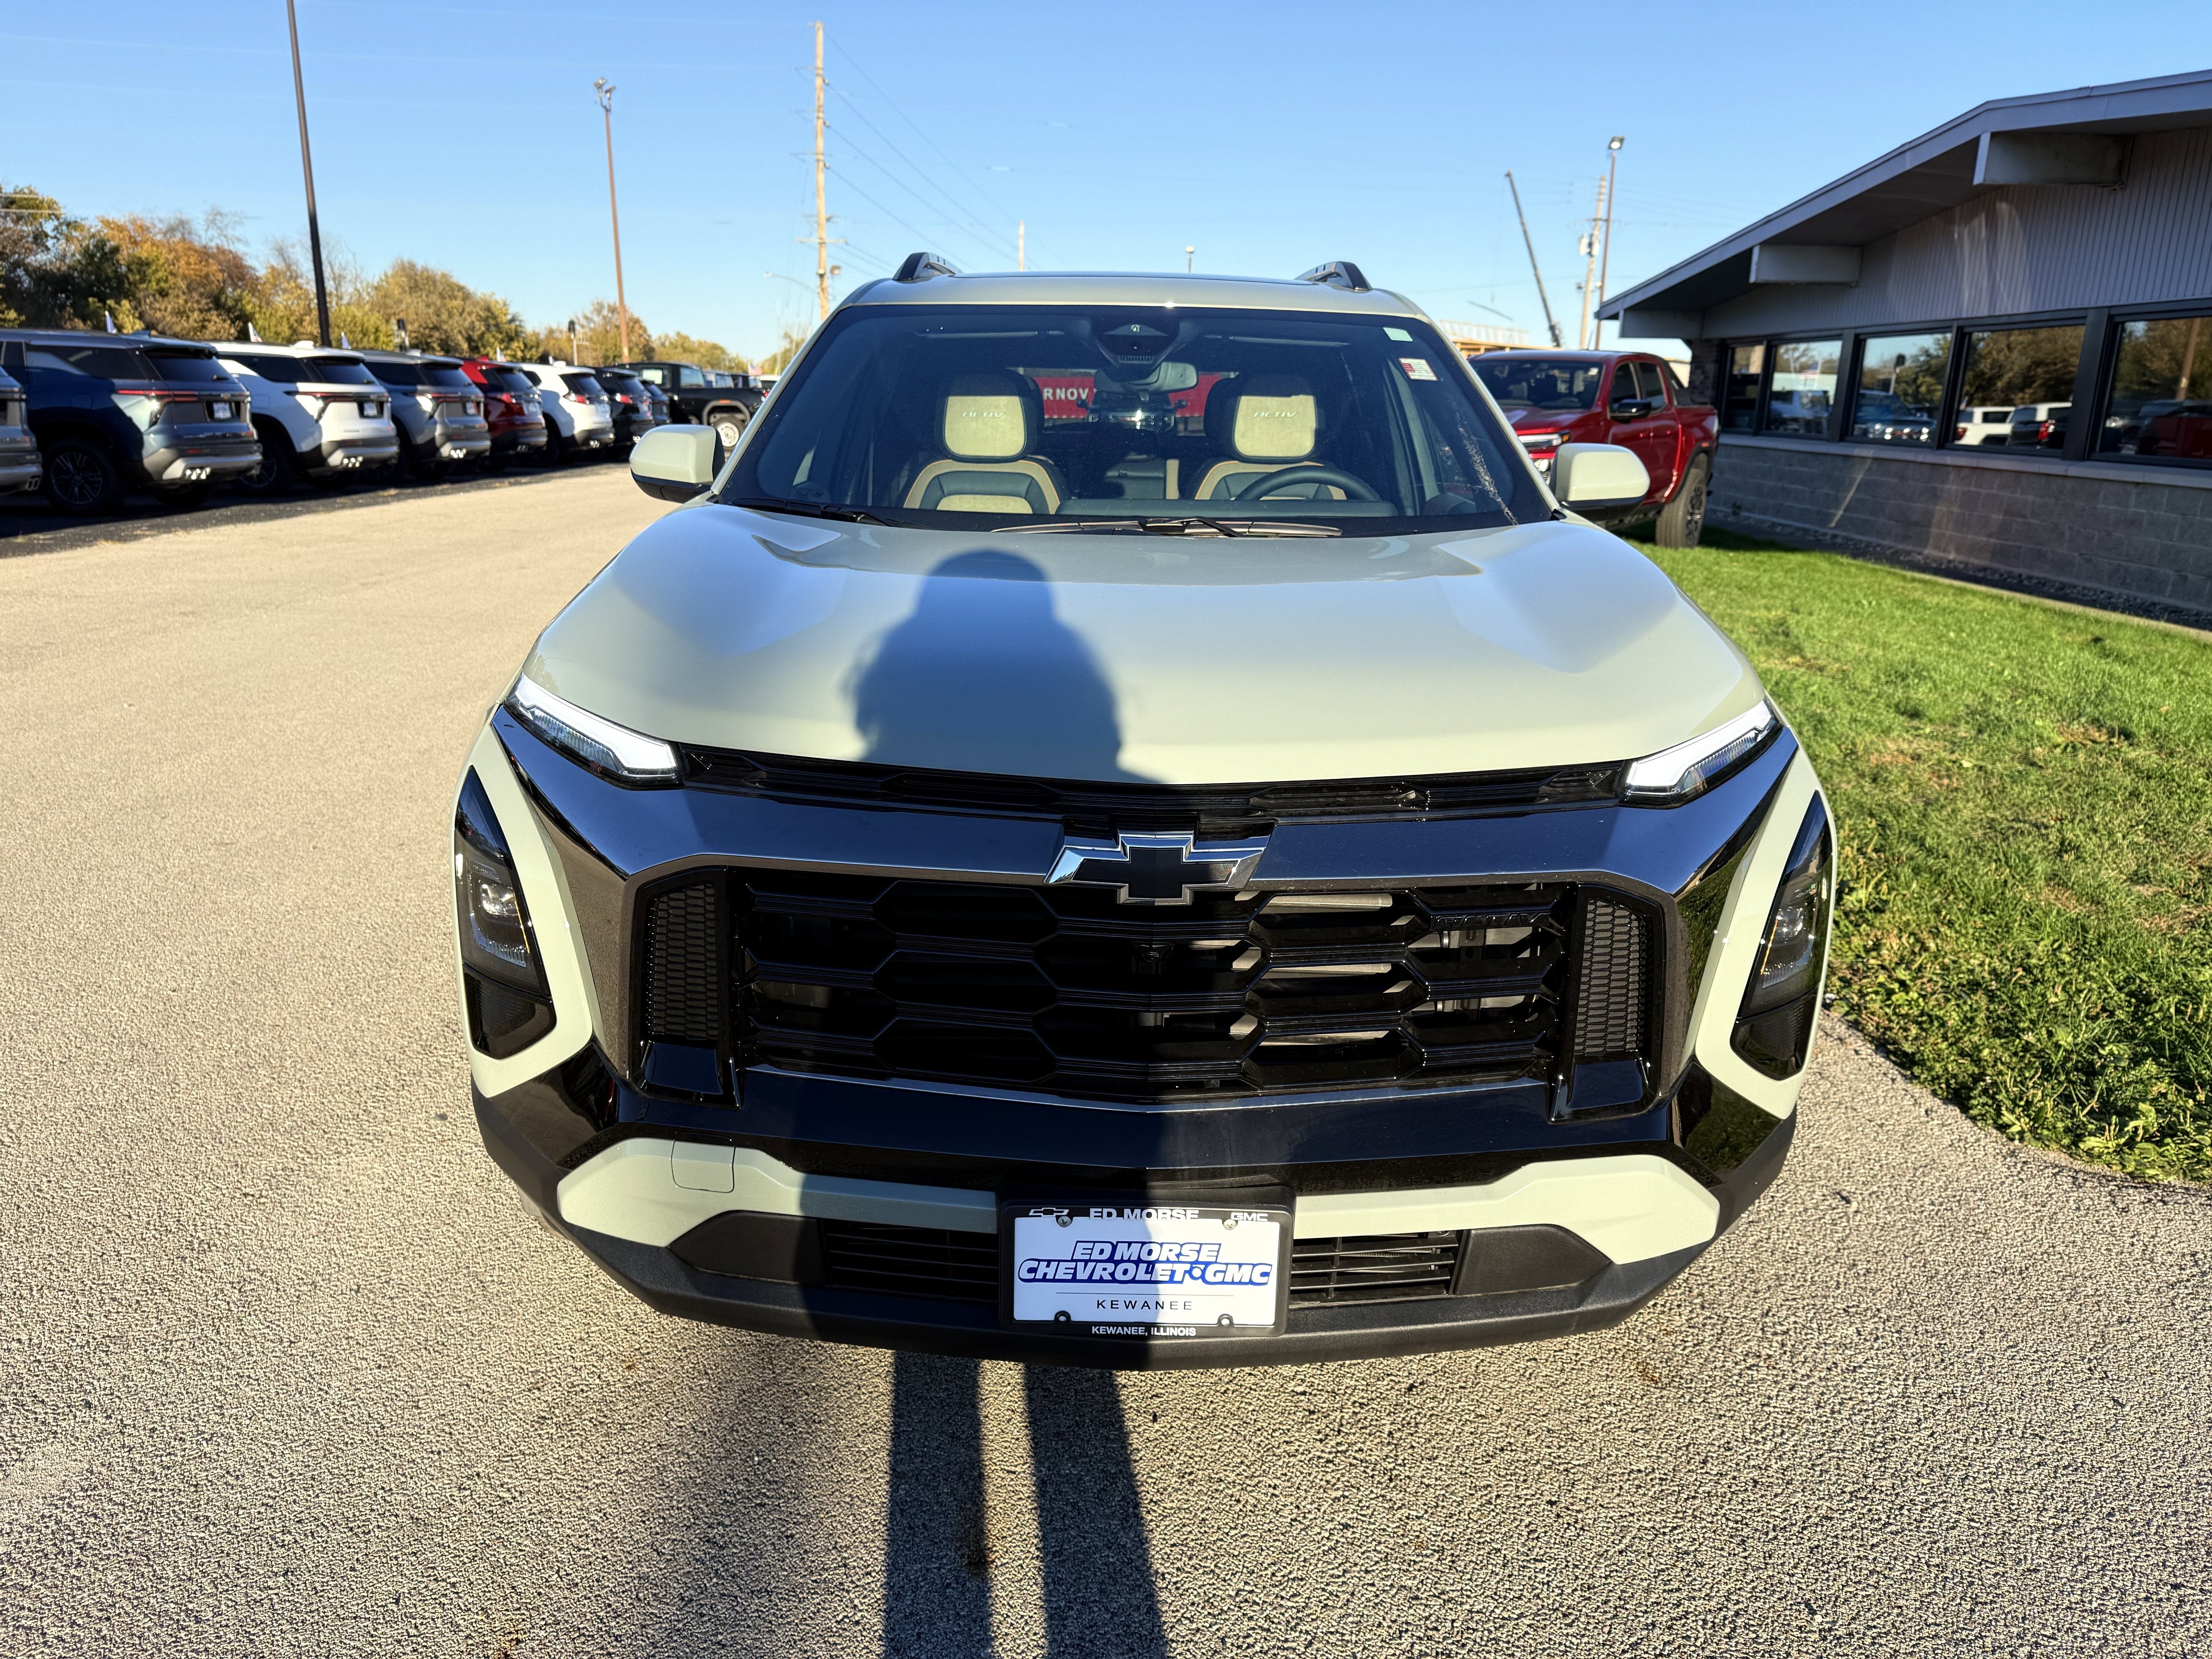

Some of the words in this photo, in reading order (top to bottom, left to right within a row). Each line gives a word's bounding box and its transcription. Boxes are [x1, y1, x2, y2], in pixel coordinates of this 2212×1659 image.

[1042, 386, 1097, 401] RNOV
[1090, 1208, 1117, 1220] ED
[1123, 1208, 1199, 1221] MORSE
[1231, 1212, 1268, 1222] GMC
[1072, 1241, 1113, 1260] ED
[1113, 1242, 1220, 1262] MORSE
[1097, 1299, 1192, 1310] KEWANEE
[1092, 1326, 1148, 1336] KEWANEE,
[1151, 1327, 1197, 1336] ILLINOIS
